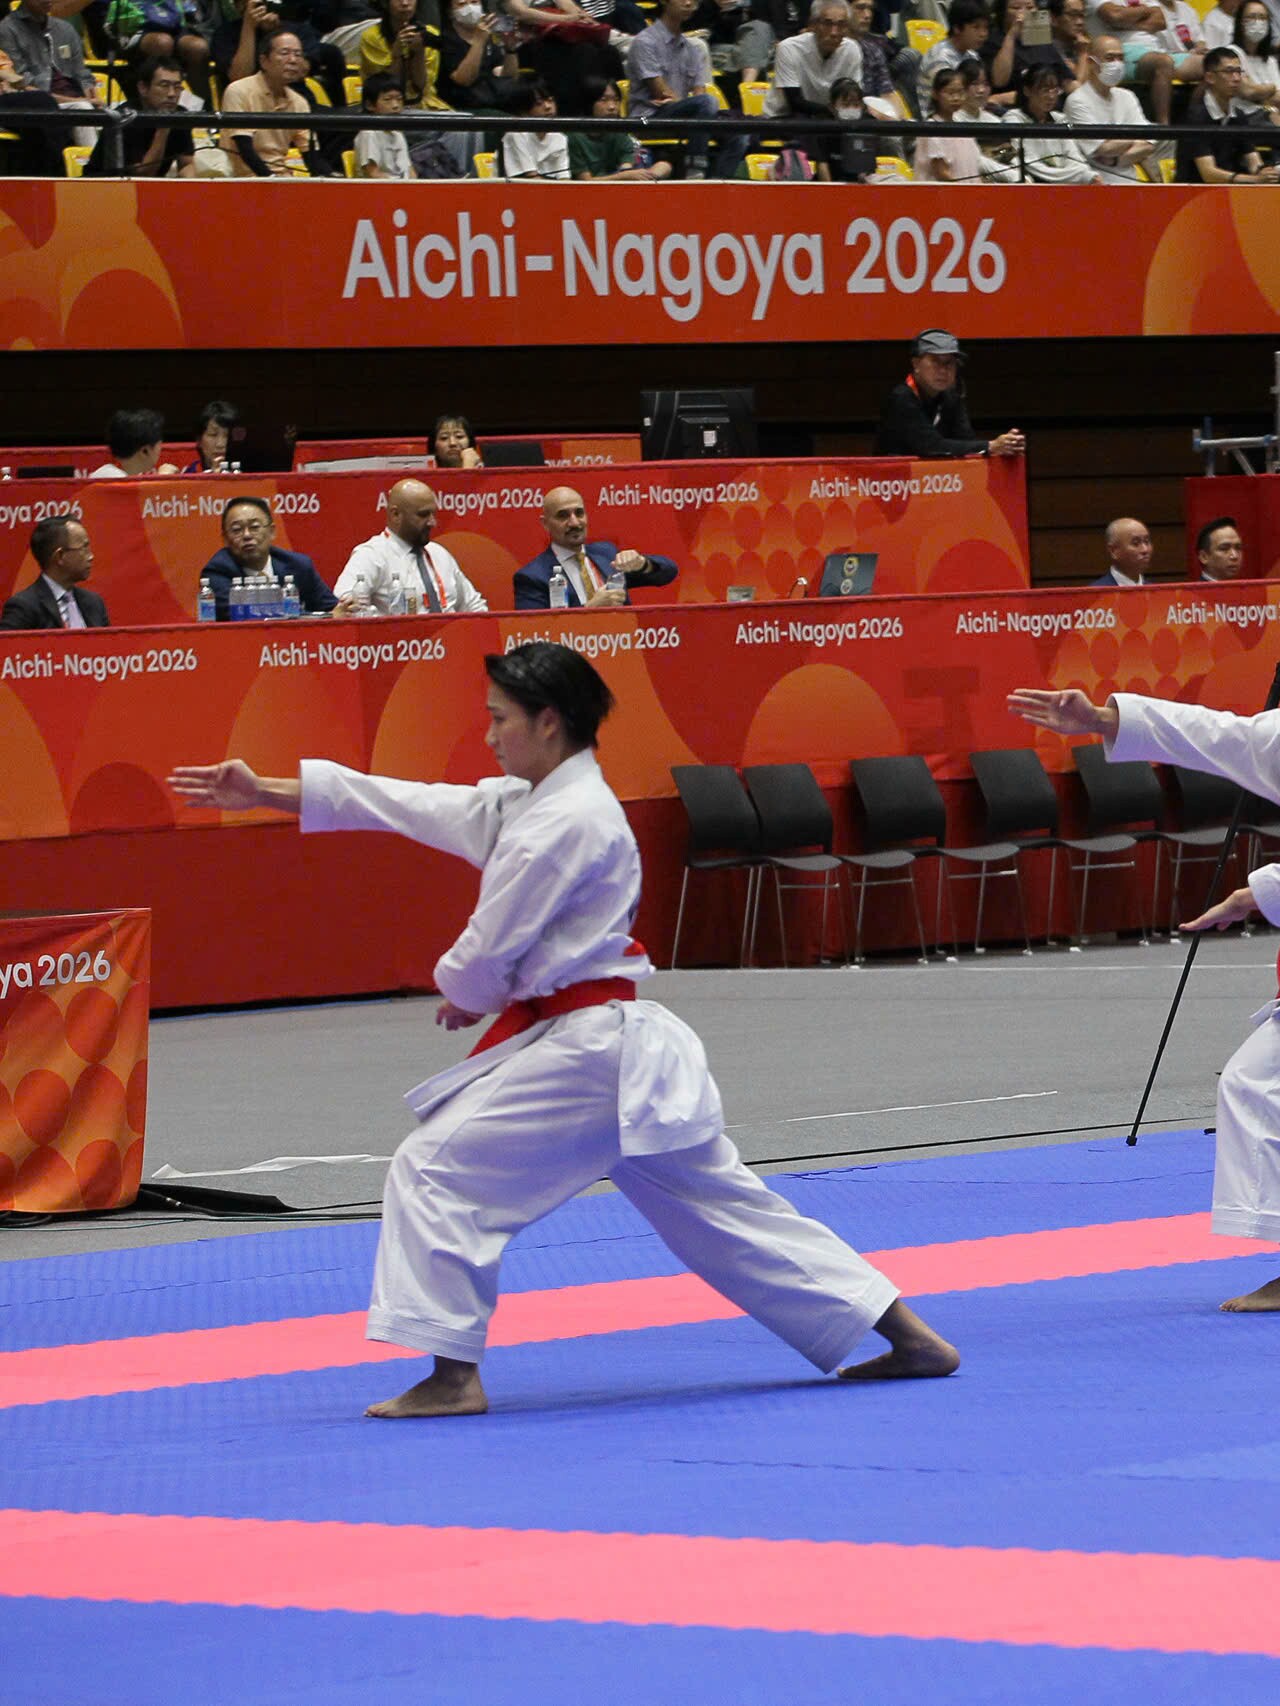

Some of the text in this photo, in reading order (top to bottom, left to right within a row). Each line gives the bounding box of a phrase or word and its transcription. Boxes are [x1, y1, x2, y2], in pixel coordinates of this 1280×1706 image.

[342, 208, 1007, 322] Aichi-Nagoya 2026
[500, 487, 545, 509] 2026
[598, 482, 760, 510] Aichi-Nagoya 2026
[810, 473, 963, 501] Aichi-Nagoya 2026
[274, 493, 320, 514] 2026
[955, 608, 1117, 637] Aichi-Nagoya 2026
[1166, 602, 1277, 628] Aichi-Nagoya
[633, 626, 680, 650] 2026
[736, 618, 903, 647] Aichi-Nagoya 2026
[1, 649, 198, 681] Aichi-Nagoya 2026
[260, 639, 446, 670] Aichi-Nagoya 2026
[38, 950, 111, 986] 2026
